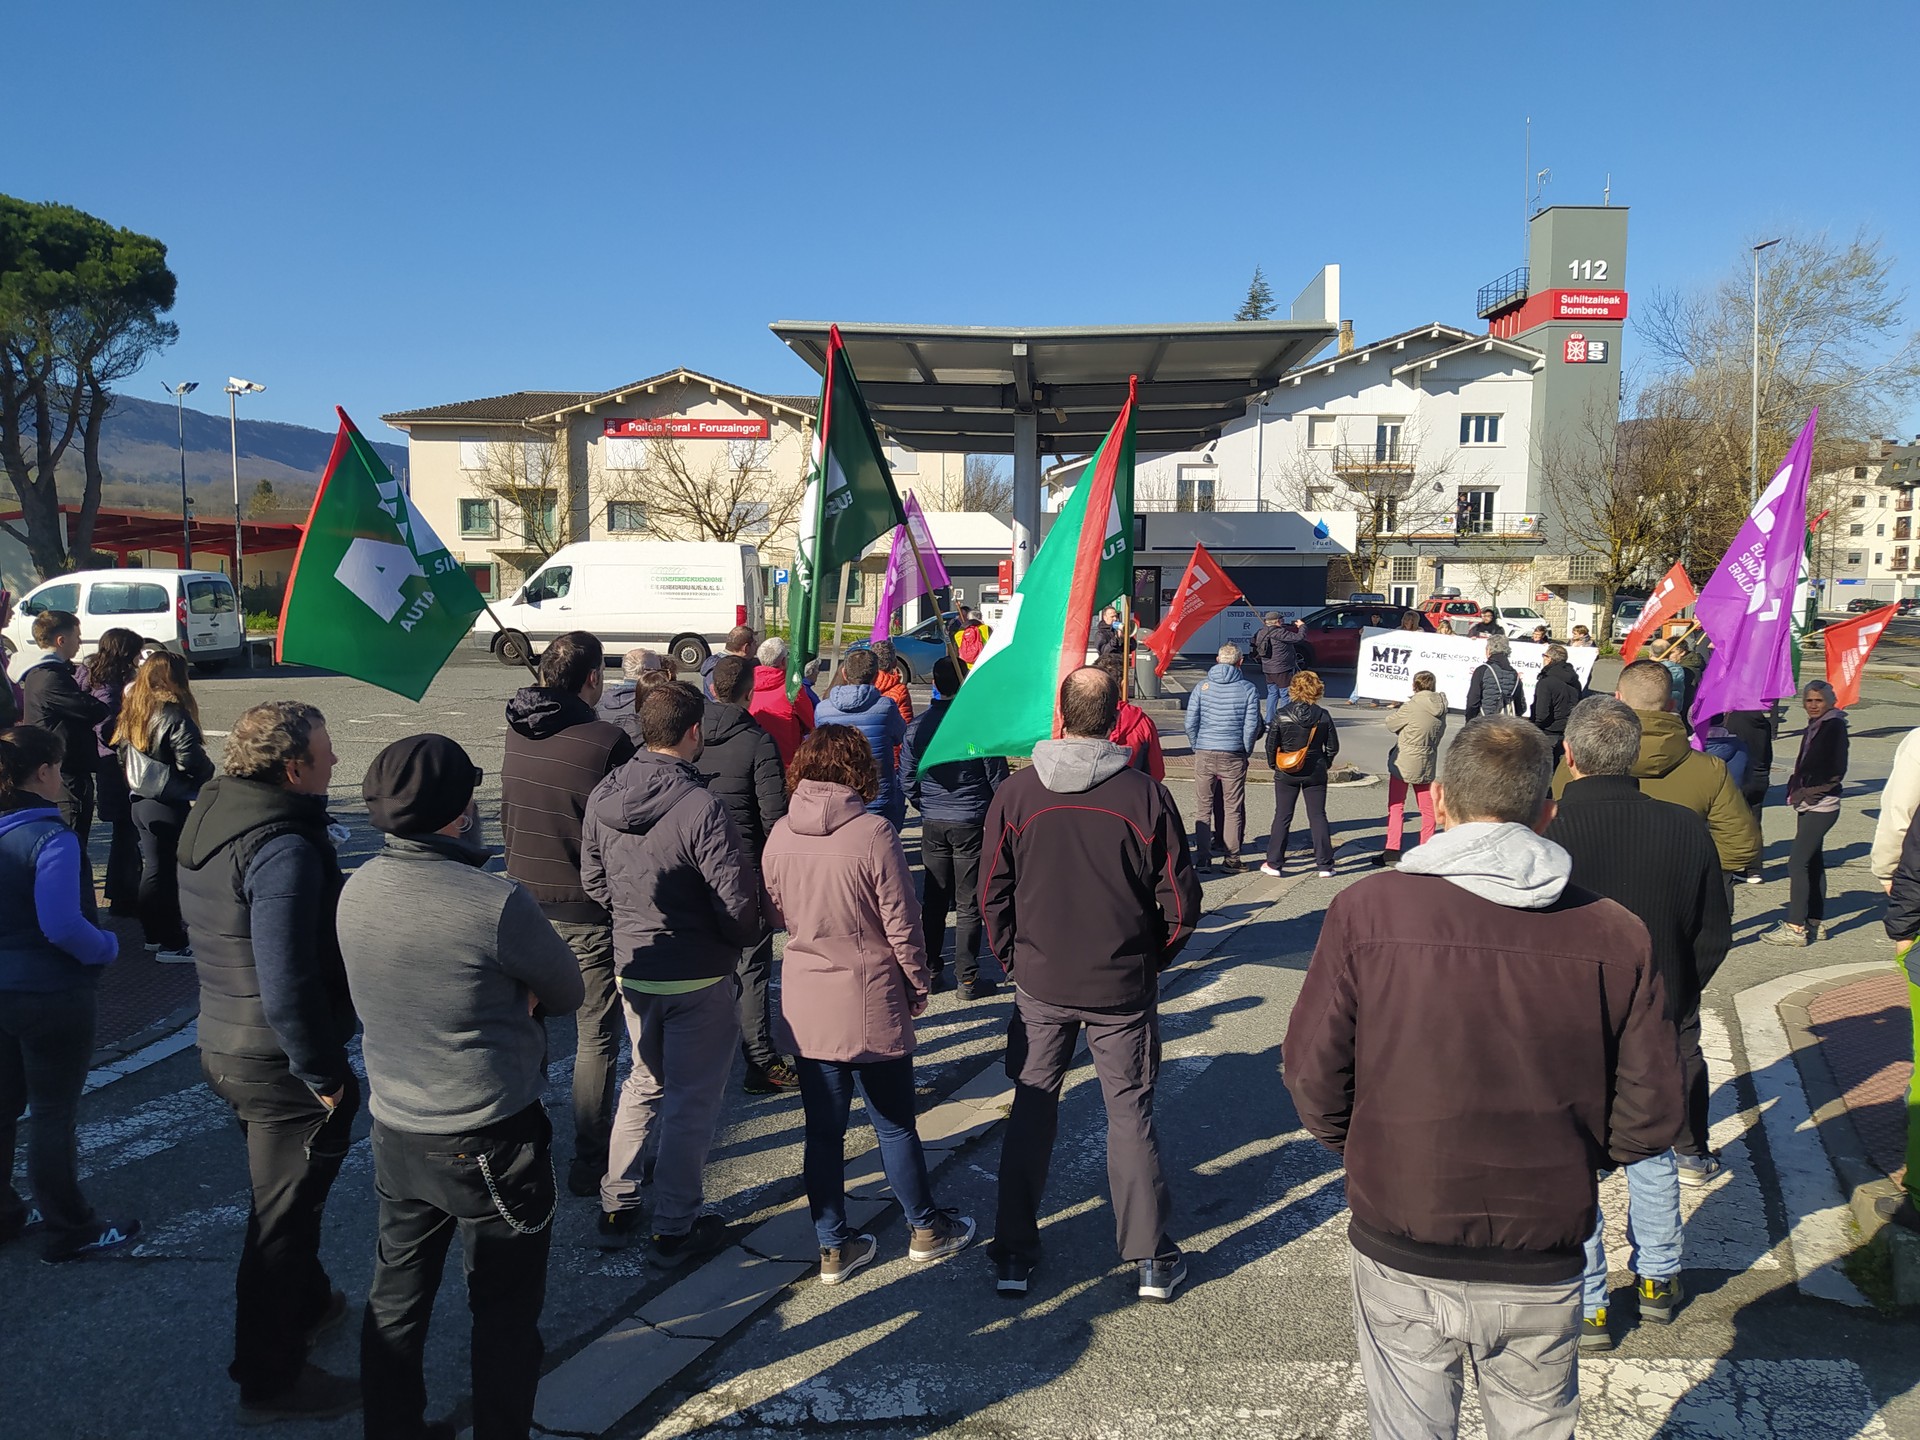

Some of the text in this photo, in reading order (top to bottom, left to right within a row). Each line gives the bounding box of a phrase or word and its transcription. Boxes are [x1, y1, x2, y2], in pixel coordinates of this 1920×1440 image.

[1568, 259, 1608, 280] 112
[1560, 294, 1621, 305] Suhiltzaileak
[1560, 305, 1609, 315] Bomberos
[665, 422, 690, 432] Foral
[699, 423, 761, 435] Foruzaingoa
[1018, 540, 1028, 551] 4
[775, 570, 786, 582] P
[1372, 645, 1413, 665] M17
[1370, 663, 1410, 677] GREBA
